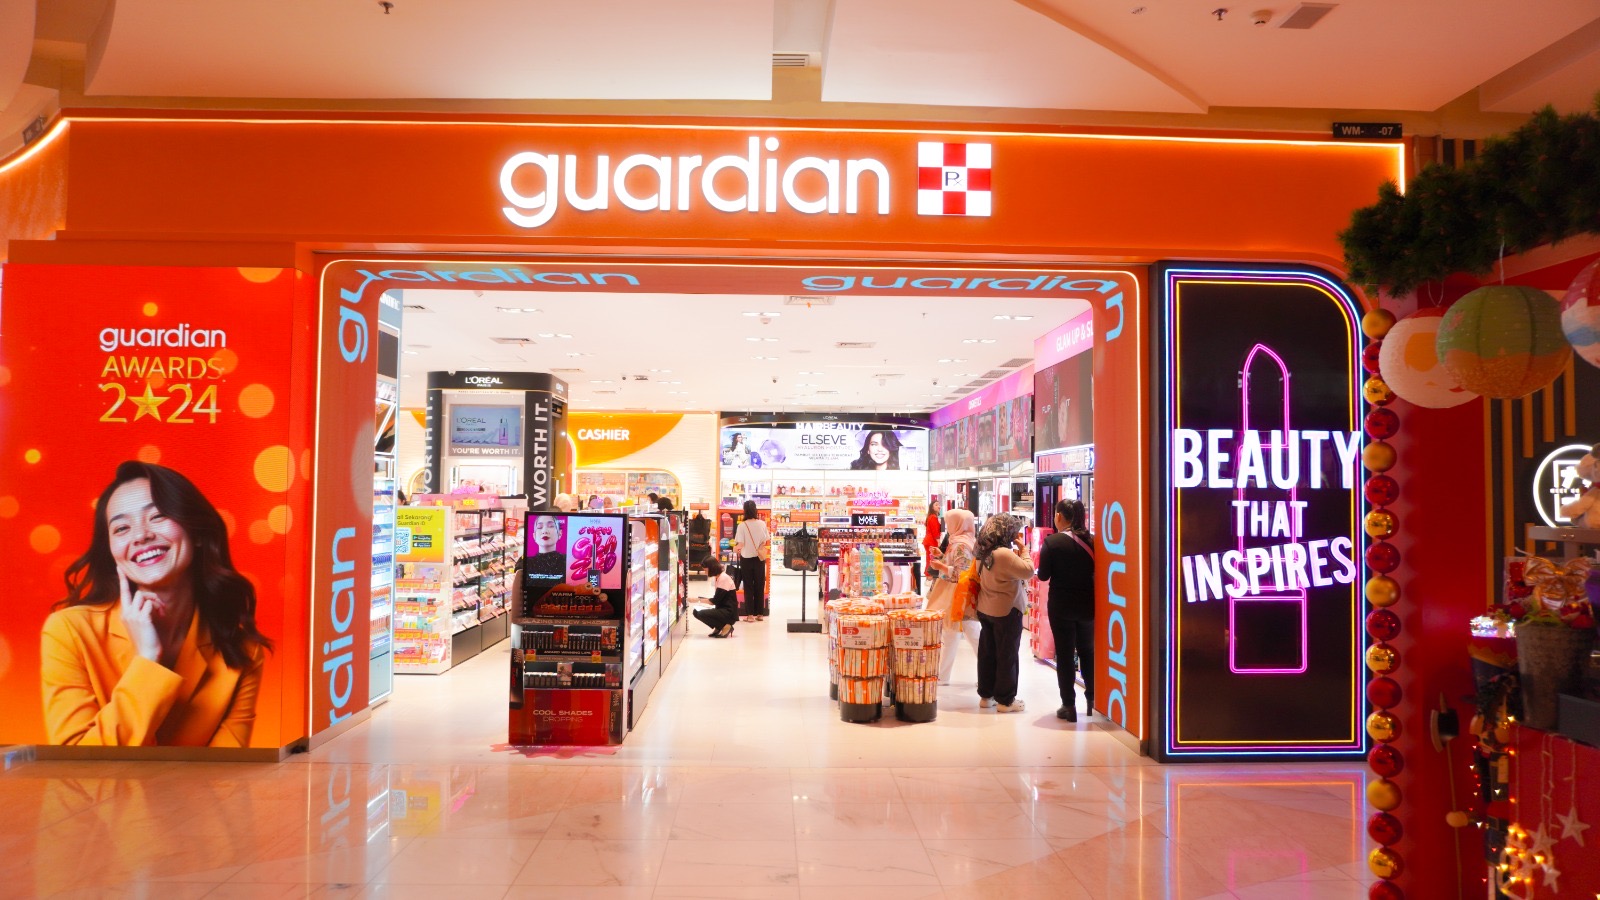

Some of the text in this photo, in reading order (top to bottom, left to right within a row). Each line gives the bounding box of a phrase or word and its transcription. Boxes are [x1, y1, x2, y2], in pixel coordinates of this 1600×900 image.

[1341, 126, 1394, 136] WM--07
[499, 136, 890, 229] guardian
[801, 275, 1125, 342] guardian
[99, 322, 227, 352] guardian
[101, 355, 224, 379] AWARDS
[99, 382, 222, 424] 224
[452, 447, 480, 455] YOU'RE
[481, 447, 510, 455] WORTH
[577, 428, 630, 441] CASHIER
[801, 434, 847, 446] ELSEVE
[533, 428, 548, 507] WORTH
[1174, 428, 1361, 489] BEAUTY
[1231, 500, 1308, 538] THAT
[1182, 536, 1357, 603] INSPIRES
